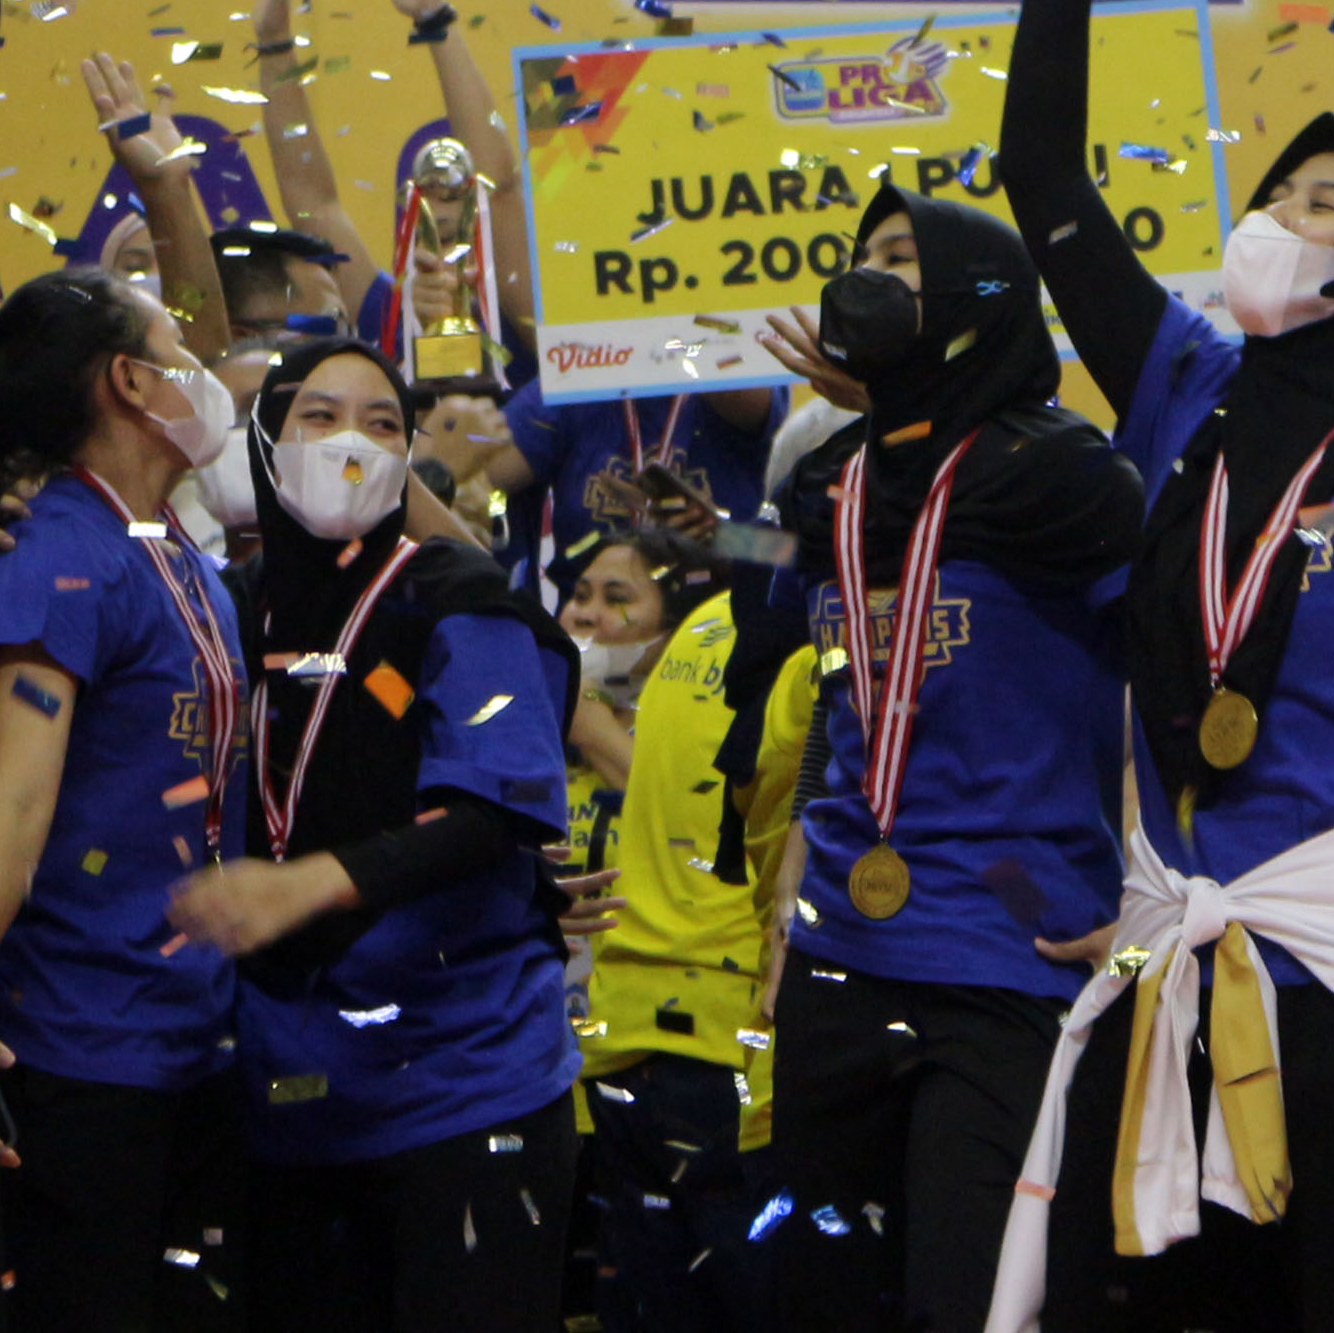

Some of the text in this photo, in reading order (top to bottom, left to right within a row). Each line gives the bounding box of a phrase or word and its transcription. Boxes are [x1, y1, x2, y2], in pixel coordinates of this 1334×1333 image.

[636, 164, 859, 226] JUARA
[594, 249, 700, 304] Rp.
[547, 342, 634, 375] Vidio
